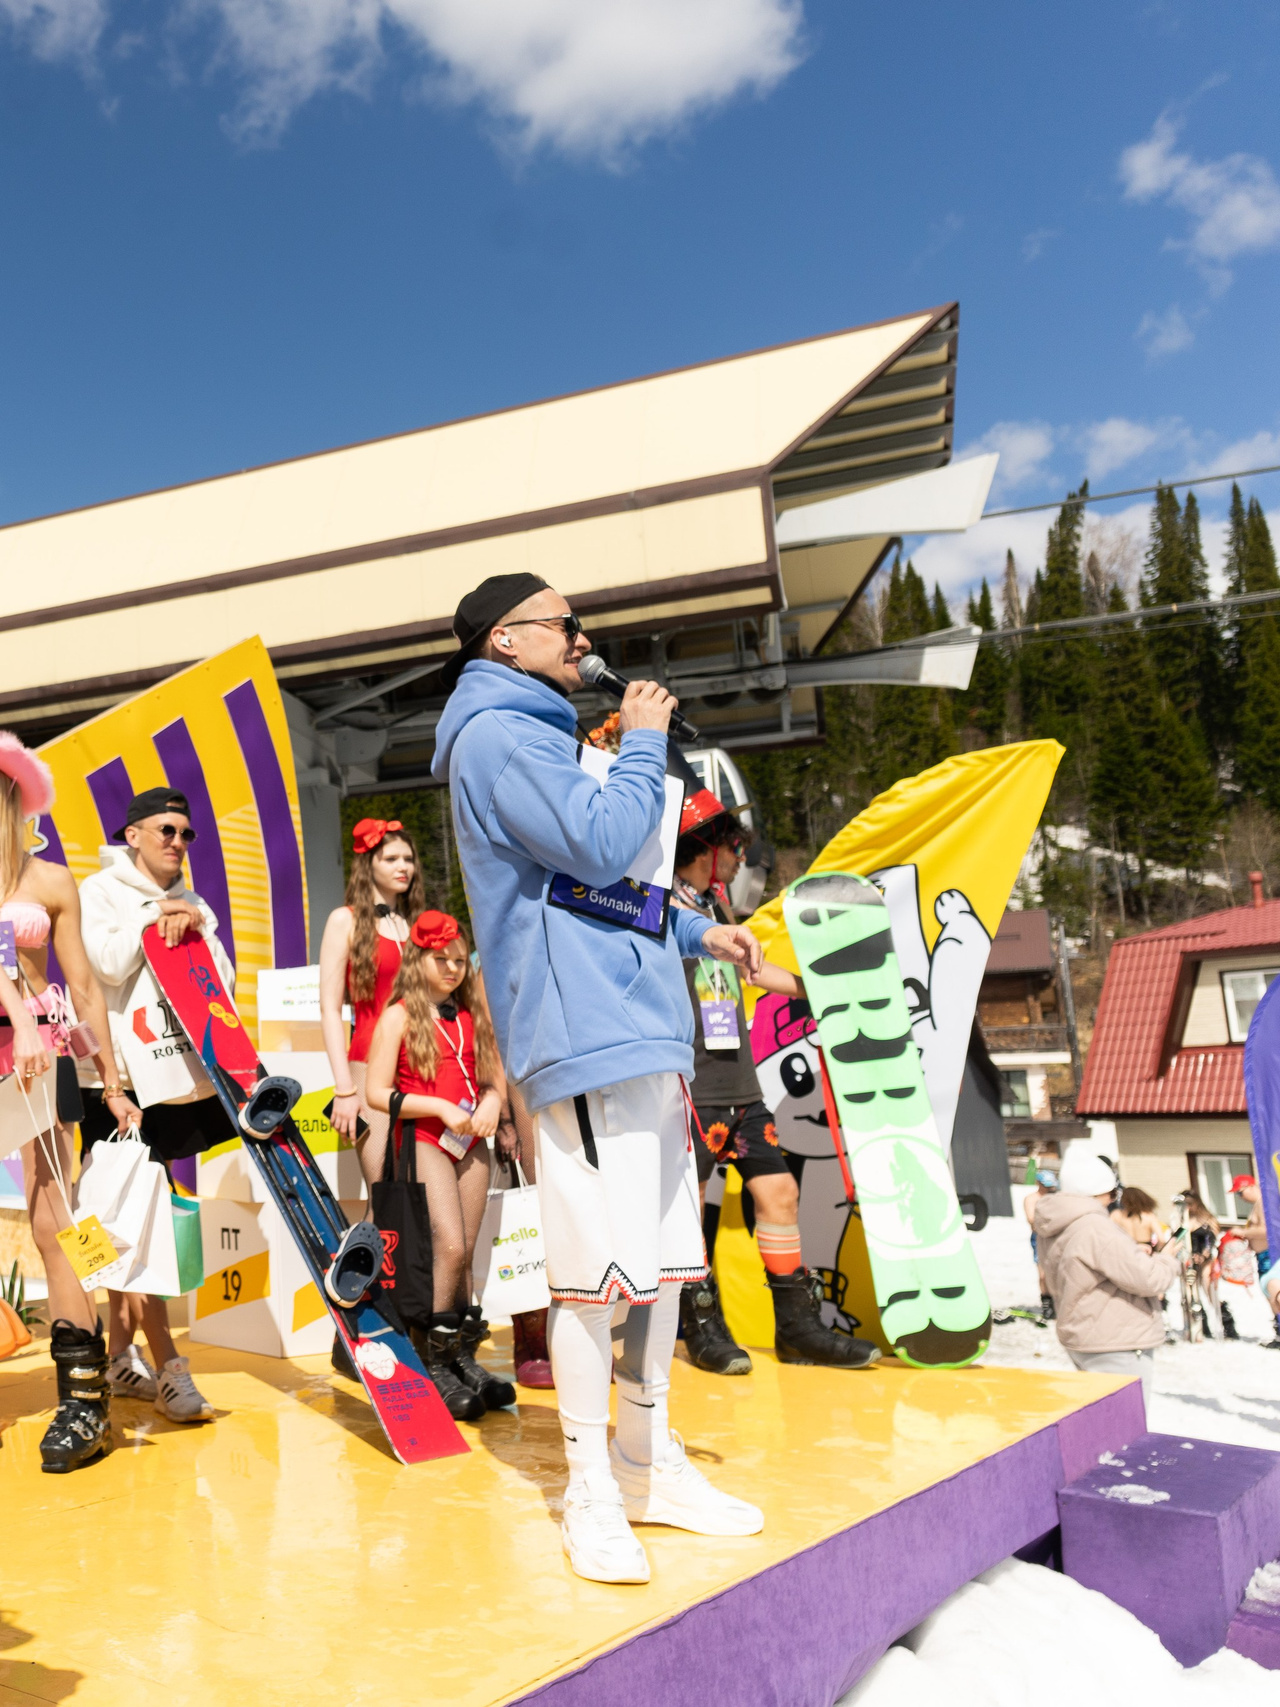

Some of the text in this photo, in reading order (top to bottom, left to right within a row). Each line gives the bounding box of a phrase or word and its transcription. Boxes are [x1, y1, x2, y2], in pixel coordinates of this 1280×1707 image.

[589, 890, 642, 917] билайн
[152, 1042, 193, 1059] ROST
[221, 1227, 241, 1251] ПТ
[87, 1253, 105, 1268] 209
[221, 1269, 242, 1302] 19
